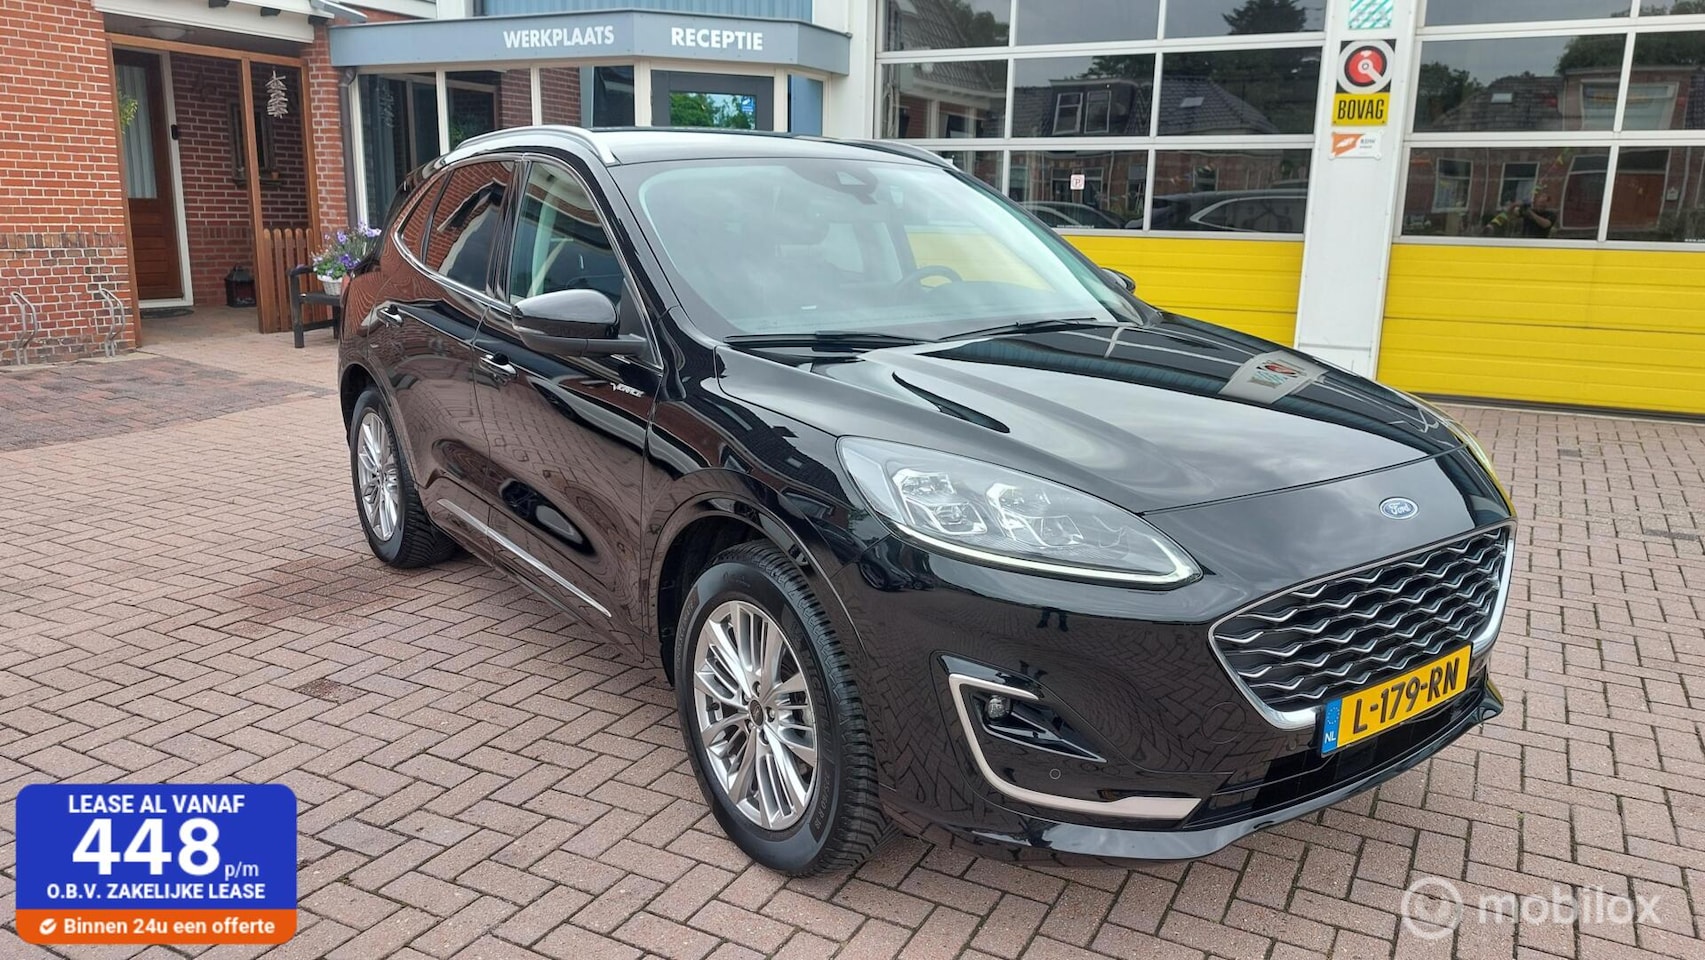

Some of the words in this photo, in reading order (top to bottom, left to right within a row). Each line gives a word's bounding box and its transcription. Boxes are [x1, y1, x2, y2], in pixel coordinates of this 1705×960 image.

[503, 25, 615, 49] WERKPLAATS
[671, 27, 763, 50] RECEPTIE
[1337, 98, 1385, 120] BOVAG
[1388, 502, 1412, 515] Ford
[1353, 657, 1460, 734] L-179-RN
[1324, 731, 1336, 744] NL
